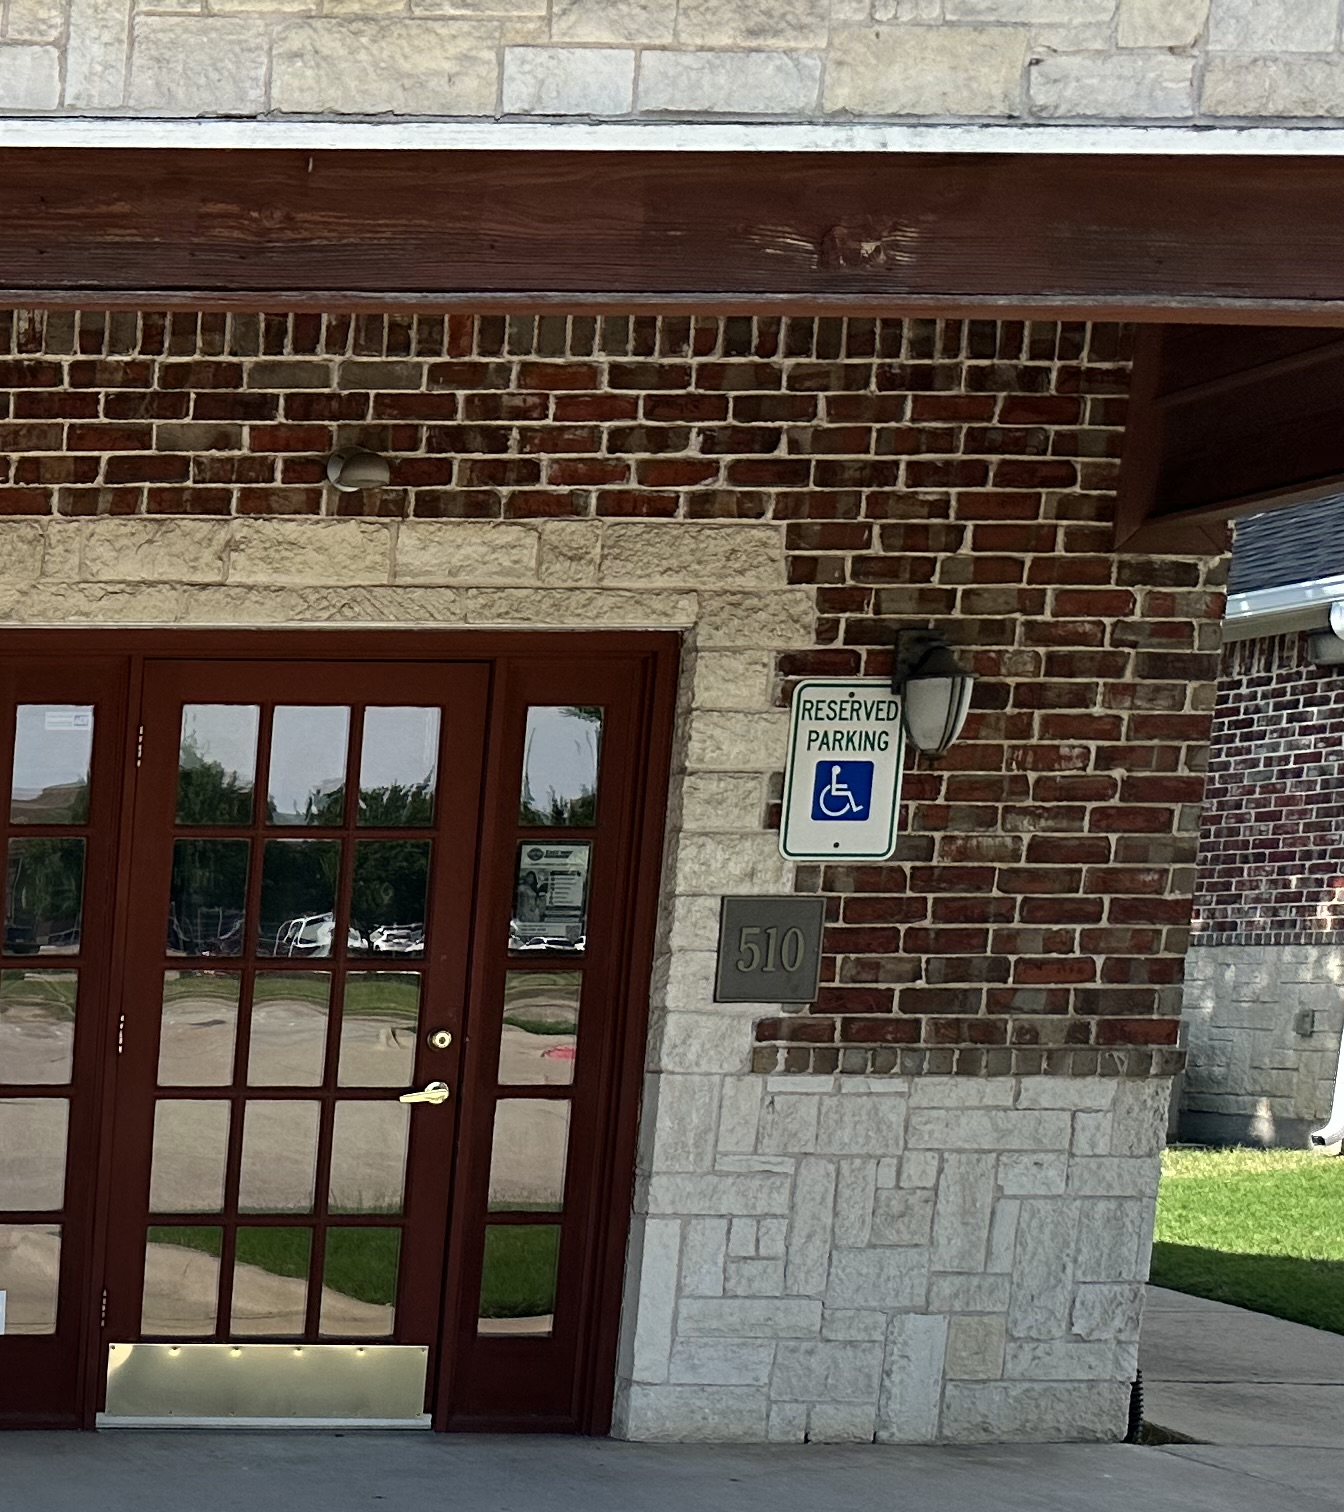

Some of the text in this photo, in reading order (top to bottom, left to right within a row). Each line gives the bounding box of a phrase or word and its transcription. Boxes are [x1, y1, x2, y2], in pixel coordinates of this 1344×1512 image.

[801, 699, 899, 722] RESERVED
[806, 730, 889, 752] PARKING
[736, 926, 805, 973] 510
